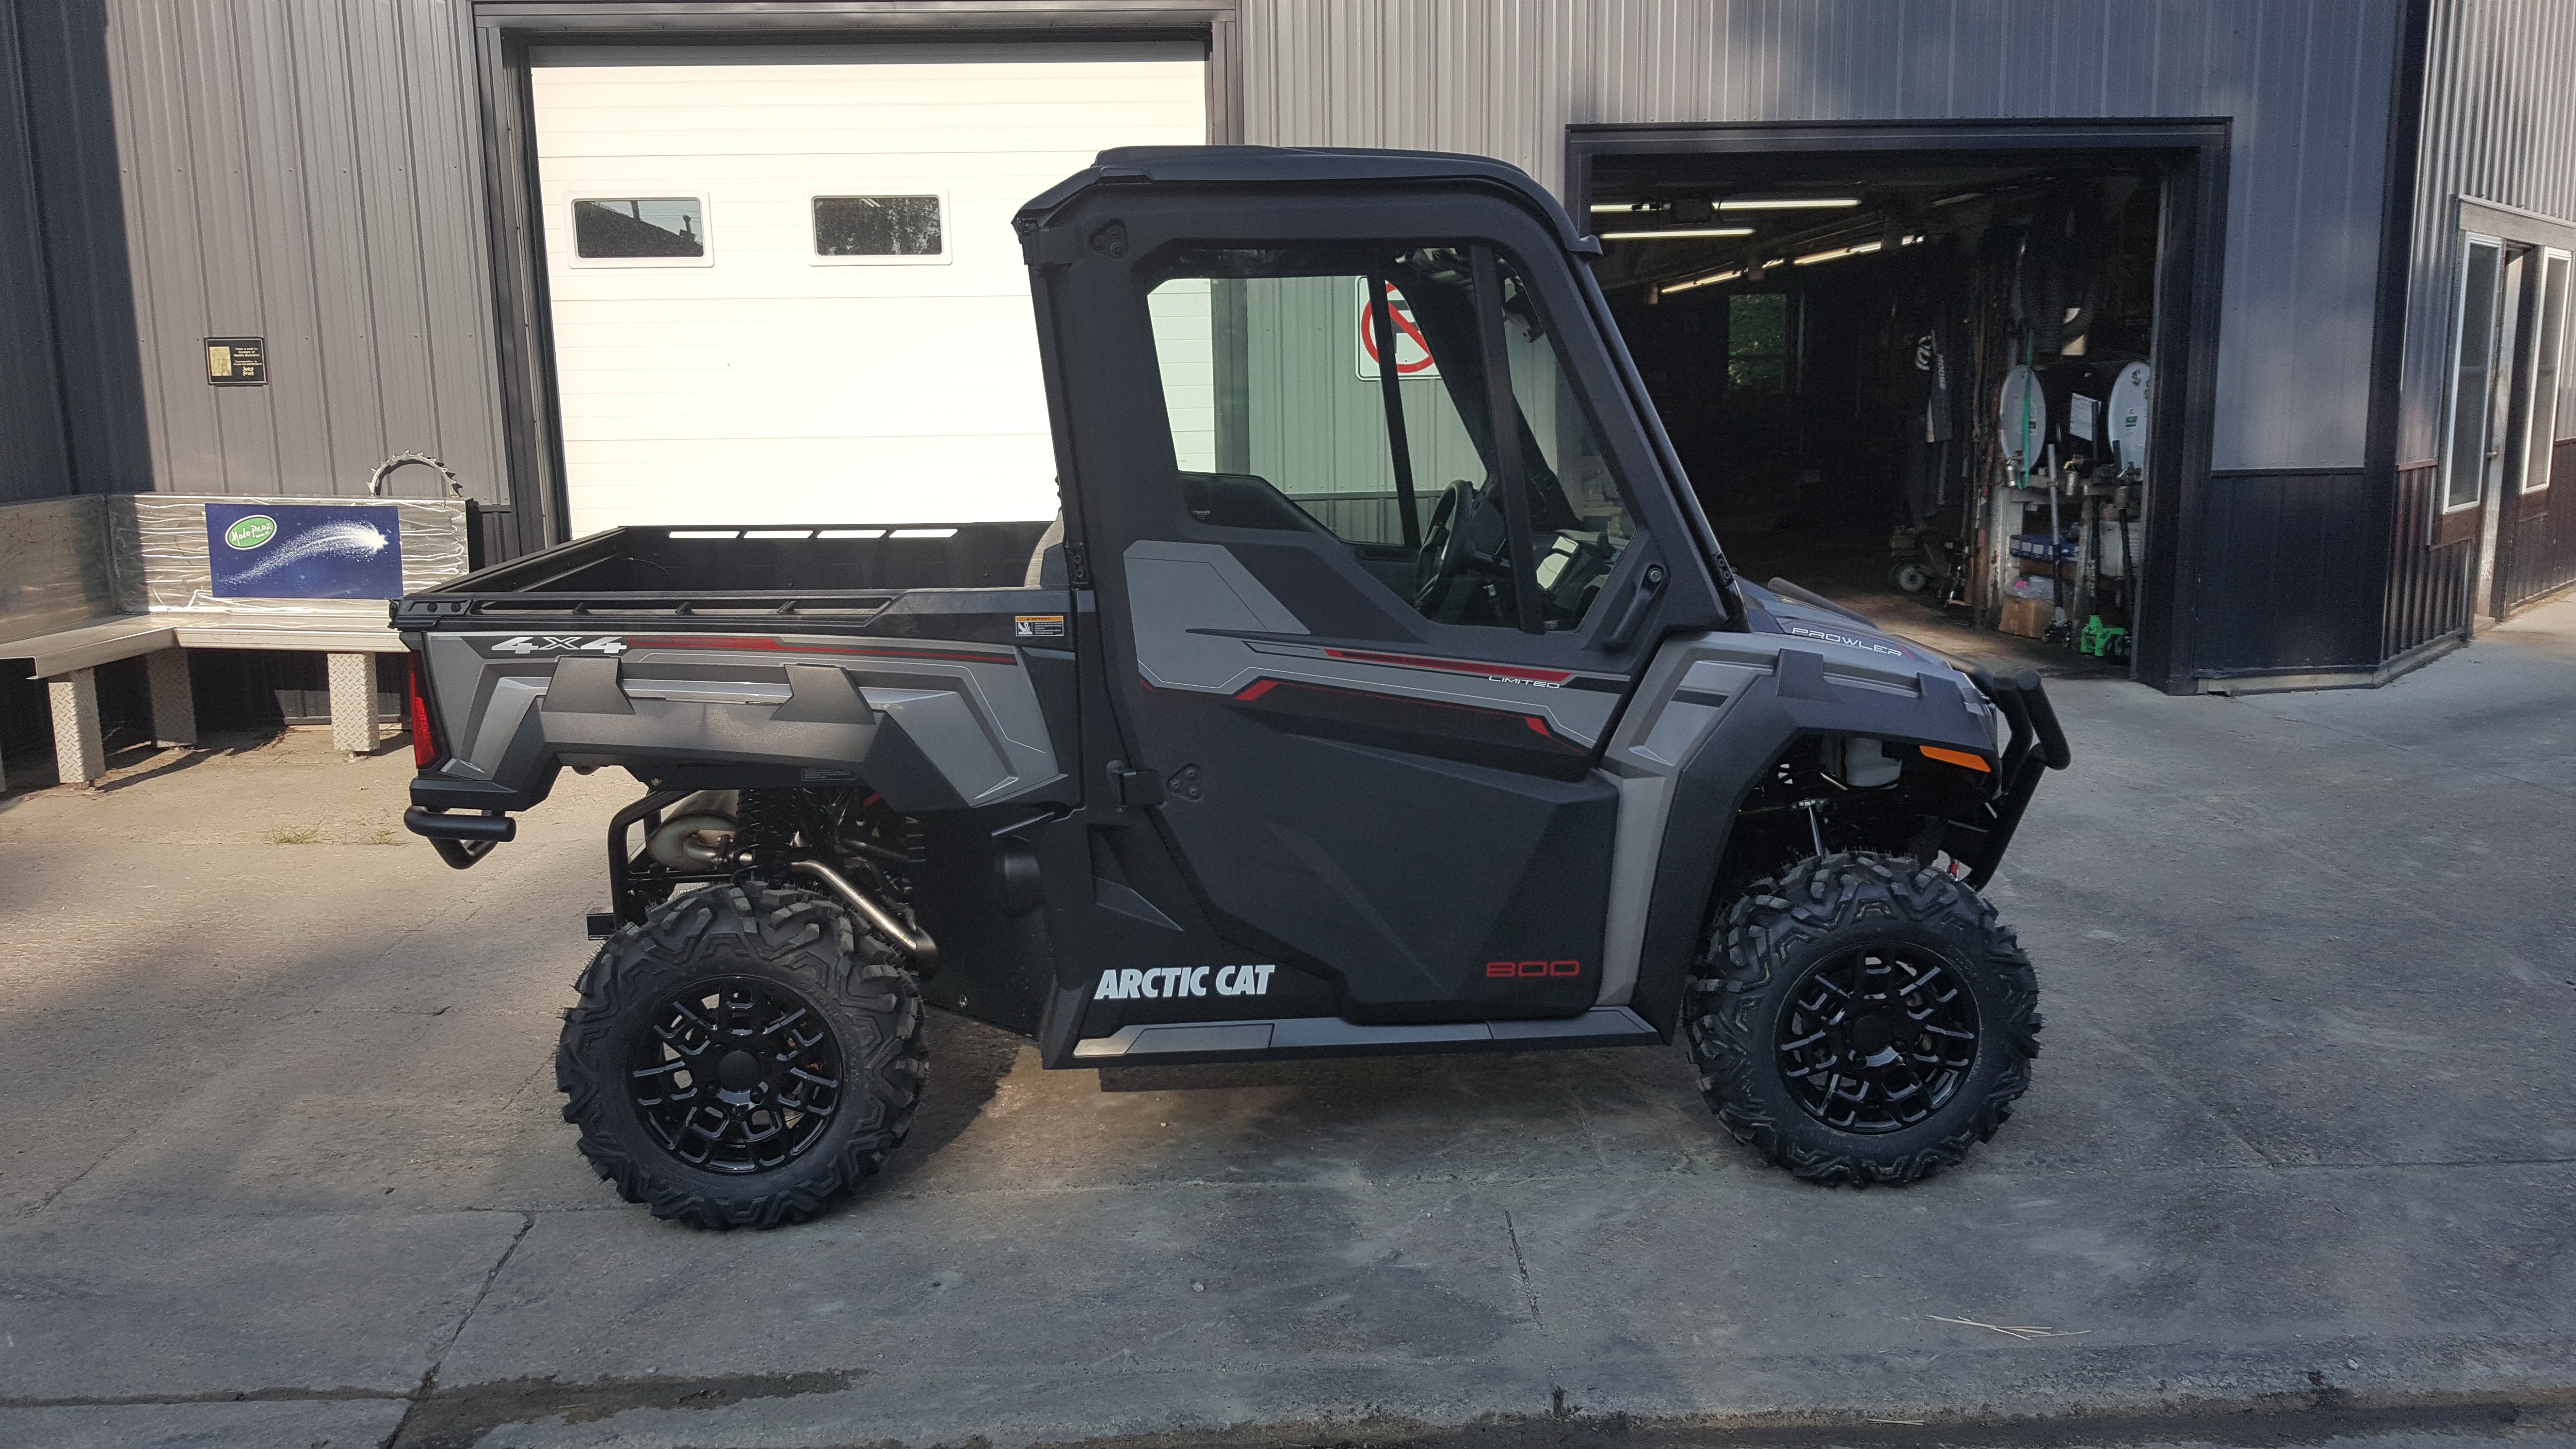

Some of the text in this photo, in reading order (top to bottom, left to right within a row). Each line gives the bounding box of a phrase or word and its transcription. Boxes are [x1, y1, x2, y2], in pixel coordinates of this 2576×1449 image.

[1792, 627, 1901, 657] PROWLER
[1488, 675, 1560, 689] LIMITED
[1486, 960, 1580, 977] 800
[1094, 965, 1275, 999] ARCTIC CAT
